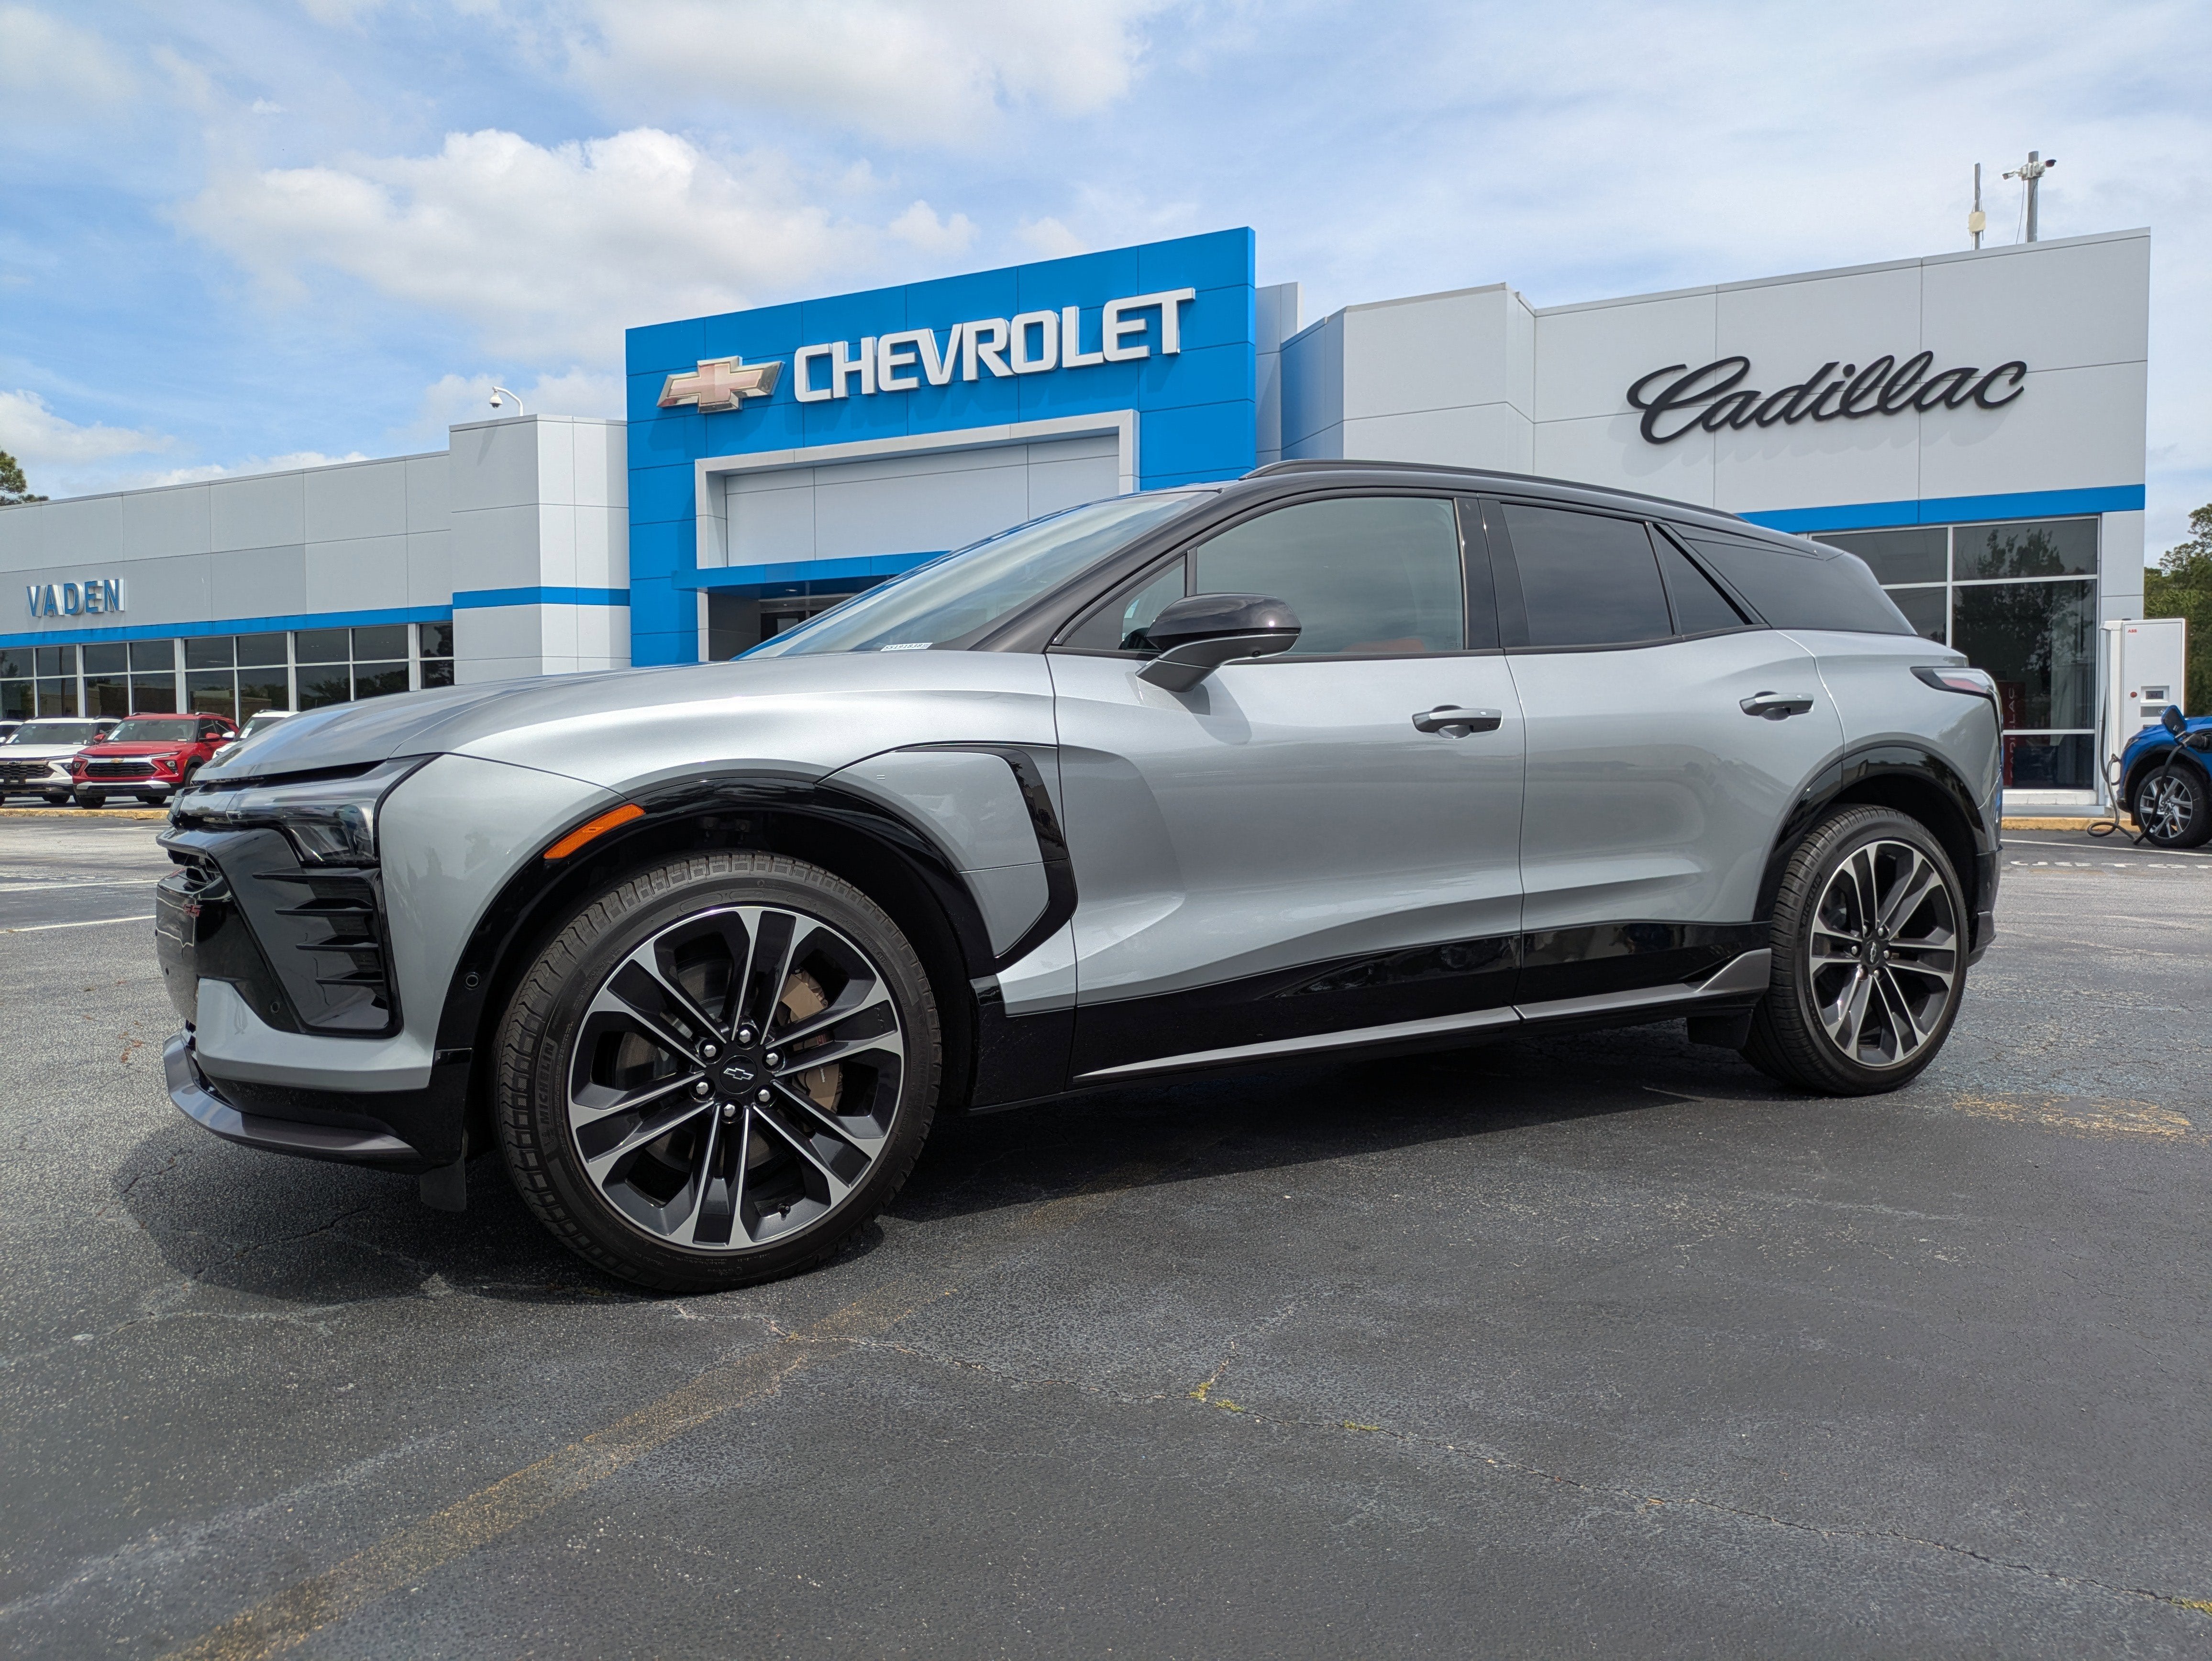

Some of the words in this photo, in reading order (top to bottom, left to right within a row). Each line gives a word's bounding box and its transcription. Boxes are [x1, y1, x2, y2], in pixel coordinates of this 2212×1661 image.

[794, 287, 1195, 403] CHEVROLET
[1626, 350, 2027, 444] Cadillac
[26, 578, 125, 617] VADEN
[539, 1041, 555, 1125] MICHELIN
